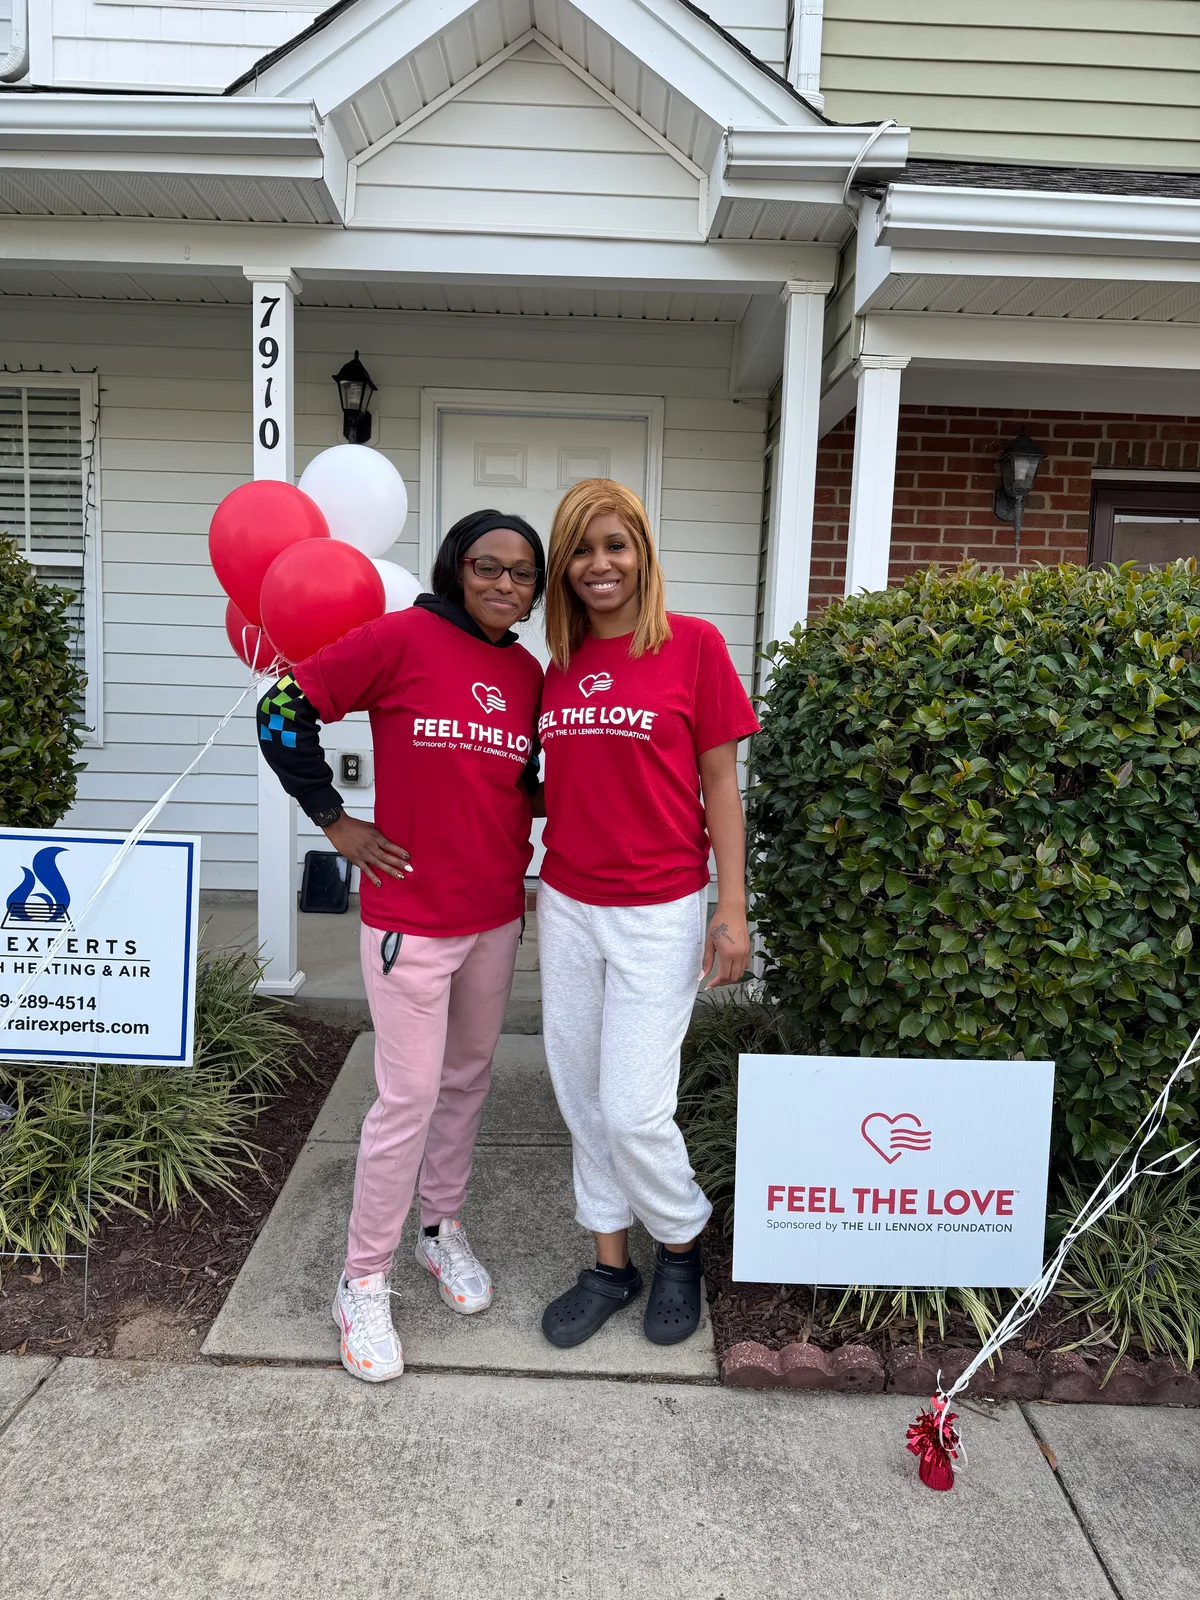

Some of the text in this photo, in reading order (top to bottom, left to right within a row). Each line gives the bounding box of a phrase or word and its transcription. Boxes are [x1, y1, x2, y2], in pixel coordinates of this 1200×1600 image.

[259, 296, 280, 449] 7910
[561, 707, 597, 724] THE
[413, 718, 463, 738] FEEL
[468, 722, 503, 745] THE
[547, 731, 554, 739] by
[605, 728, 651, 741] FOUNDATION
[412, 740, 446, 748] Sponsored
[448, 742, 457, 750] by
[459, 742, 472, 750] THE
[483, 747, 507, 758] LENNOX
[102, 965, 113, 976] &
[118, 965, 151, 978] AIR
[767, 1185, 845, 1213] FEEL
[852, 1188, 918, 1214] THE
[766, 1219, 821, 1231] Sponsored
[825, 1221, 838, 1233] by
[841, 1222, 864, 1231] THE
[885, 1222, 933, 1232] LENNOX
[937, 1223, 1013, 1233] FOUNDATION
